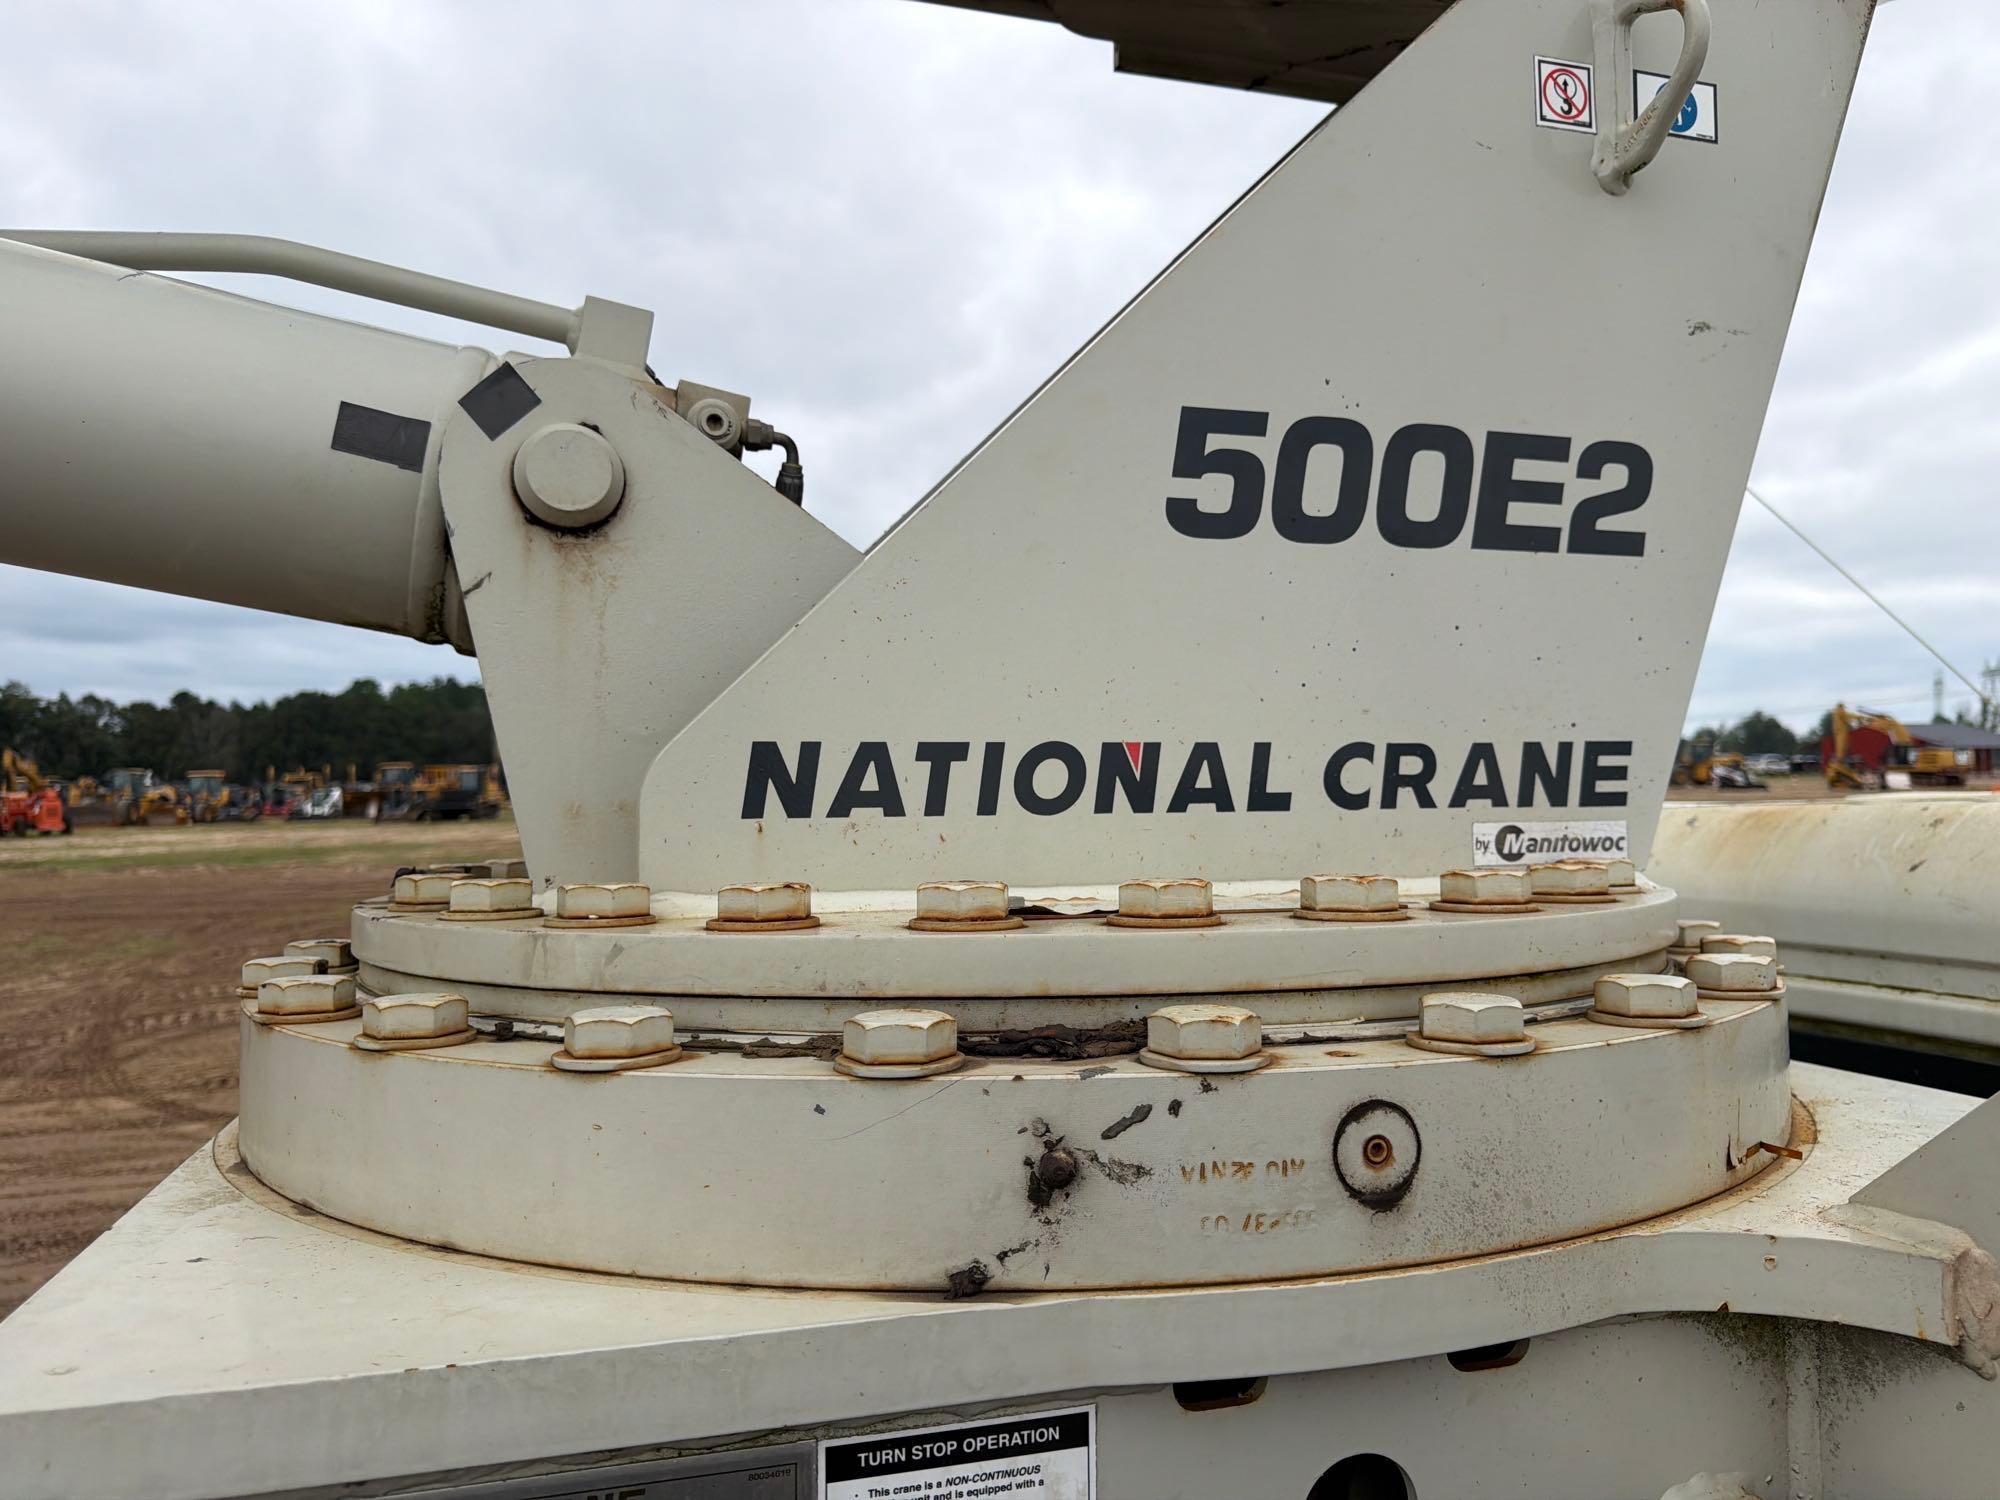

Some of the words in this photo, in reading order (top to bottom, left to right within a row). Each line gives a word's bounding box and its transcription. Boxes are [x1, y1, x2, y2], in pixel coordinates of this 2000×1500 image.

[1165, 405, 1654, 558] 500E2
[741, 740, 1293, 819] NATIONAL
[1323, 741, 1633, 811] CRANE
[1475, 837, 1490, 855] by
[1496, 826, 1625, 861] Manitowoc
[857, 1447, 906, 1467] TURN
[911, 1440, 958, 1460] STOP
[962, 1426, 1060, 1453] OPERATION
[868, 1487, 890, 1499] This
[893, 1483, 922, 1495] crane
[924, 1481, 934, 1491] is
[936, 1481, 943, 1489] a
[945, 1464, 1042, 1487] NON-CONTINUOUS
[955, 1489, 964, 1499] is
[966, 1482, 1013, 1499] equipped
[1015, 1478, 1036, 1490] with
[1038, 1479, 1045, 1487] a
